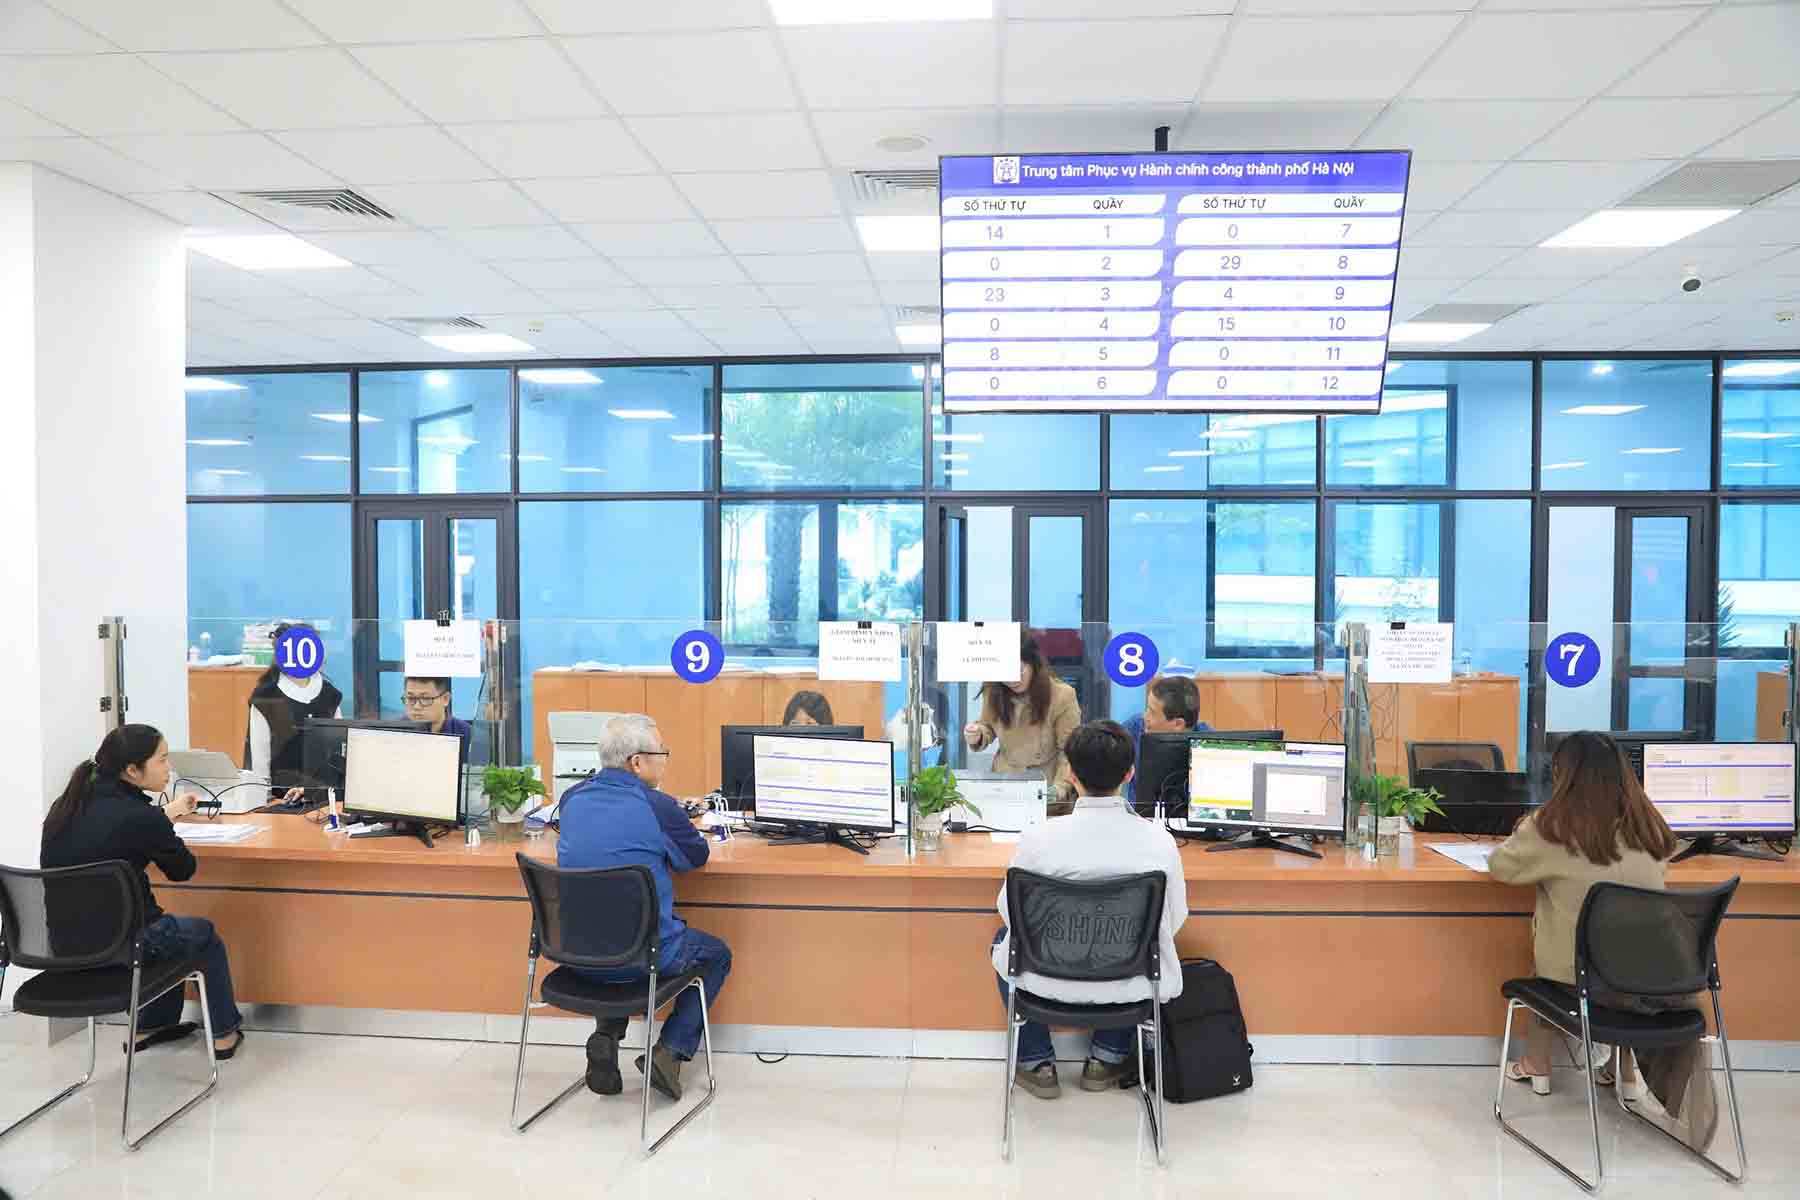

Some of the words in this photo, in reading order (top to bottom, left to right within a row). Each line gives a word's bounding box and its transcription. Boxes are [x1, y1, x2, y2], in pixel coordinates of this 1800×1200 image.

[1022, 165, 1057, 180] Trung
[1061, 164, 1084, 177] tâm
[1088, 163, 1118, 179] Phục
[1121, 166, 1137, 179] vụ
[1140, 163, 1171, 176] Hành
[1175, 163, 1209, 176] chính
[1212, 163, 1243, 178] công
[1246, 163, 1281, 175] thành
[1285, 161, 1311, 176] phố
[1312, 162, 1329, 175] Hà
[1333, 161, 1354, 176] Nội
[964, 199, 979, 211] SỐ
[1010, 200, 1027, 212] TỰ
[1203, 196, 1219, 208] SỐ
[1222, 196, 1247, 208] THỨ
[986, 225, 1004, 240] 14
[1103, 224, 1111, 239] 1
[1228, 224, 1239, 239] 0
[1341, 224, 1352, 238] 7
[990, 257, 1001, 271] 0
[1101, 256, 1112, 271] 2
[1221, 256, 1241, 270] 29
[1337, 255, 1349, 269] 8
[985, 287, 1006, 303] 23
[1100, 287, 1111, 301] 3
[1223, 286, 1234, 300] 4
[1335, 286, 1345, 300] 9
[990, 318, 1000, 332] 0
[1098, 317, 1109, 331] 4
[1217, 316, 1236, 331] 15
[1328, 315, 1346, 330] 10
[990, 347, 1001, 361] 8
[1098, 347, 1108, 361] 5
[1218, 346, 1230, 361] 0
[1326, 345, 1342, 360] 11
[990, 377, 1001, 391] 0
[1097, 376, 1107, 390] 6
[1216, 376, 1228, 391] 0
[1322, 375, 1339, 390] 12
[282, 637, 317, 669] 10
[685, 641, 711, 673] 9
[1117, 643, 1146, 677] 8
[1559, 643, 1586, 677] 7
